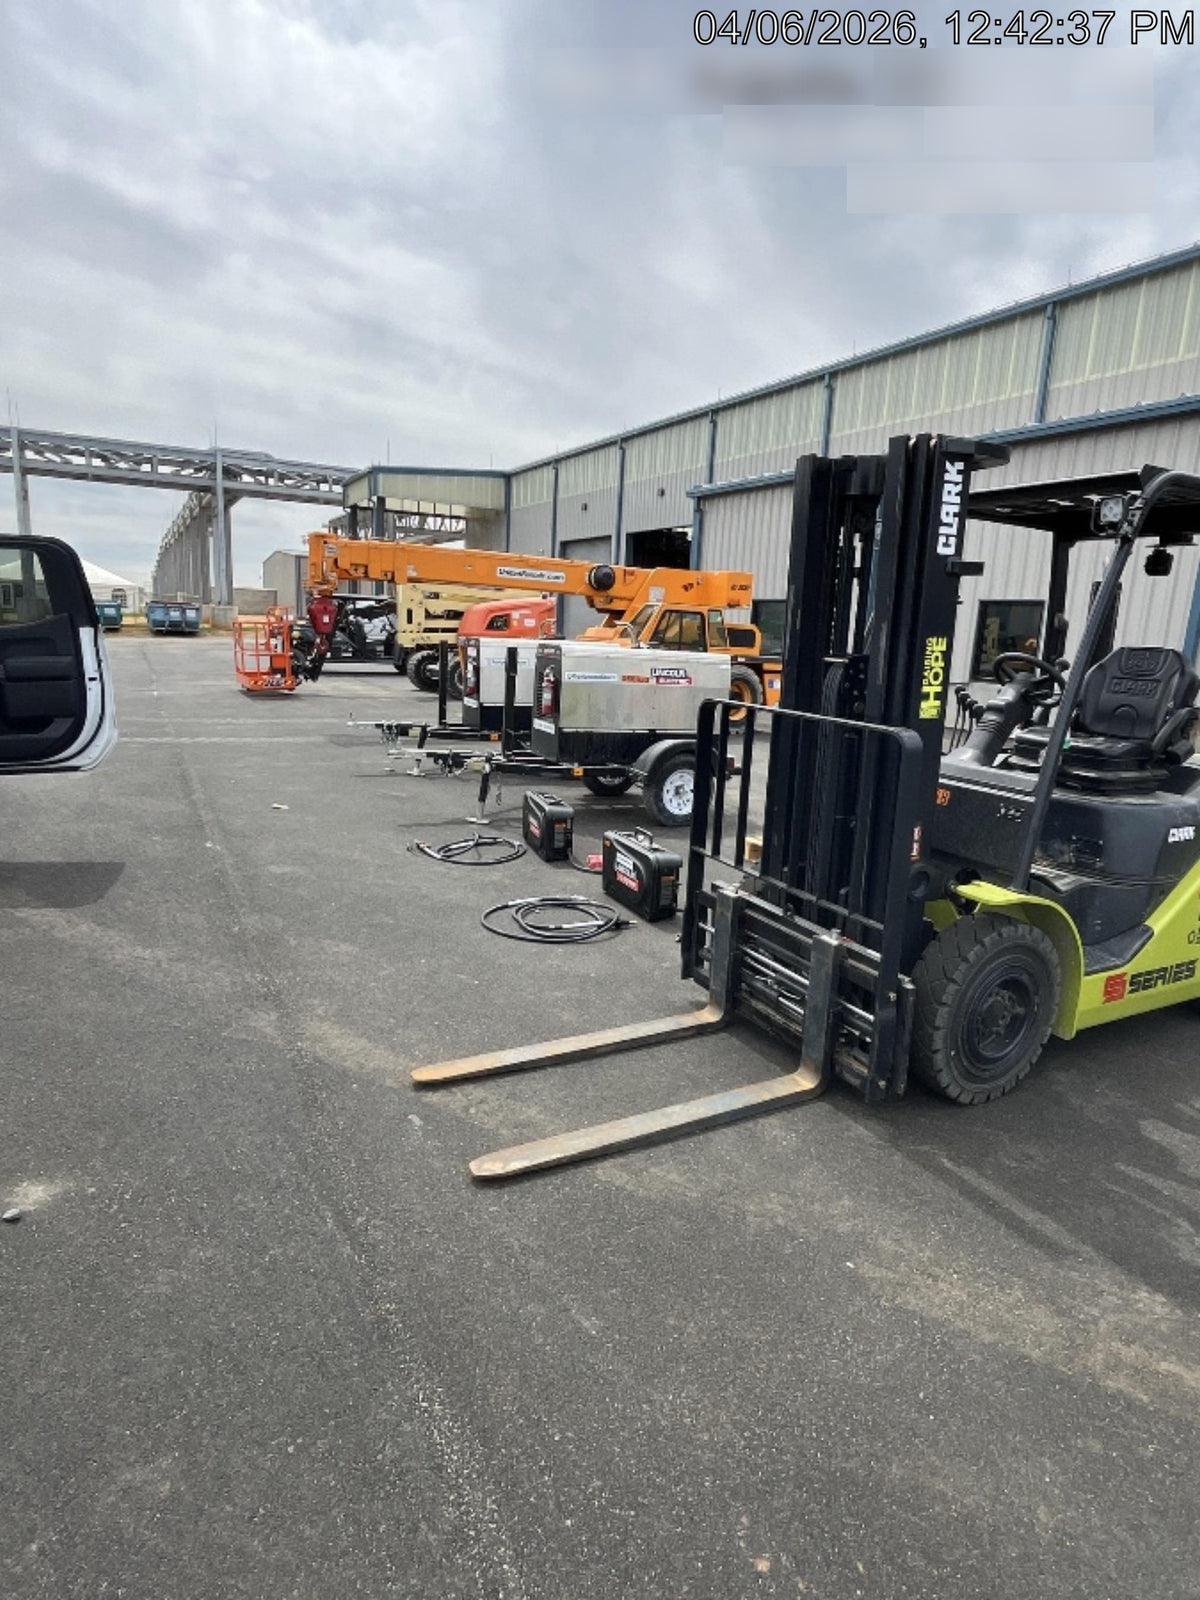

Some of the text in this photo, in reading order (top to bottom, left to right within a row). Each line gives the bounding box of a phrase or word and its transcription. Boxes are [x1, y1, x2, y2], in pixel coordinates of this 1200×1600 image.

[937, 460, 964, 555] CLARK
[920, 636, 946, 709] HOPE
[1128, 959, 1198, 994] SERIES
